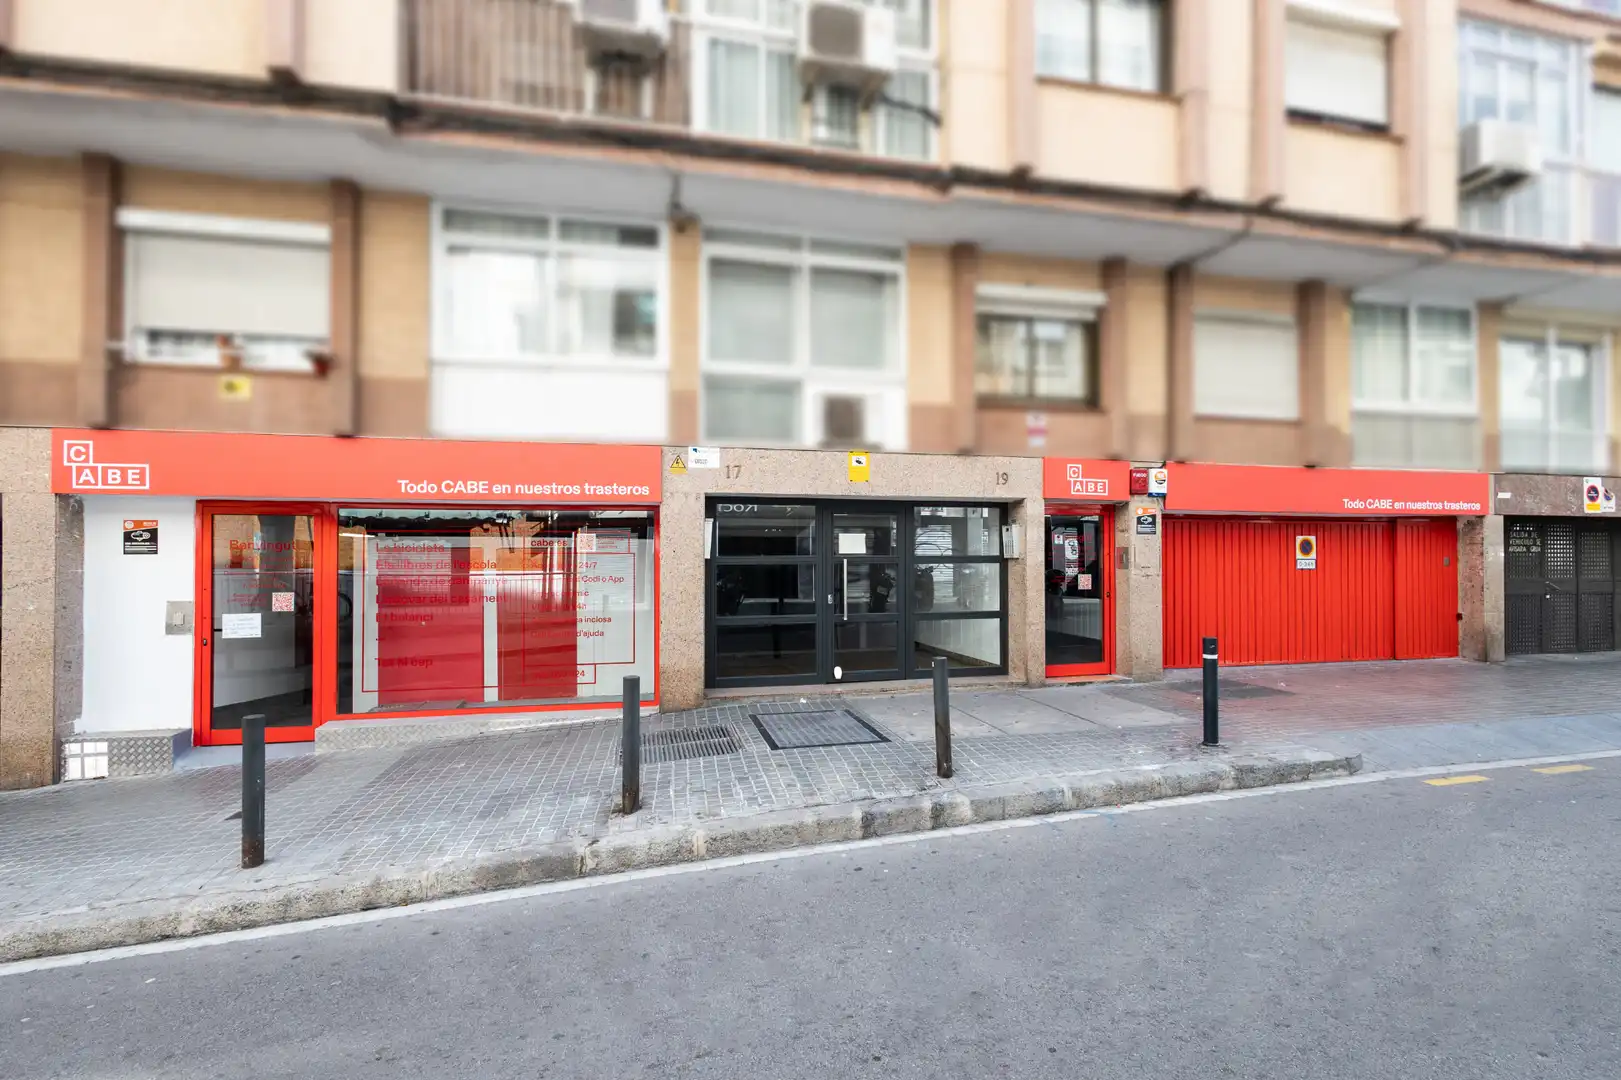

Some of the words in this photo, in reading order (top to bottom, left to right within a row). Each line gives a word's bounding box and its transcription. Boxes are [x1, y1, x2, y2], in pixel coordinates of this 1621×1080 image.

[725, 465, 741, 479] 17
[996, 472, 1008, 485] 19
[398, 480, 437, 494] Todo
[441, 480, 489, 494] CABE
[492, 483, 511, 494] en
[515, 482, 581, 495] nuestros
[584, 482, 649, 495] trasteros
[1343, 498, 1364, 508] Todo
[1366, 499, 1392, 509] CABE
[1406, 501, 1442, 510] nuestros
[1444, 501, 1481, 510] trasteros
[393, 543, 445, 553] bicicleta
[530, 539, 568, 547] cabe.es
[453, 559, 497, 569] l'escola
[581, 575, 600, 583] Codi
[608, 575, 624, 584] App
[576, 630, 605, 638] d'ajuda
